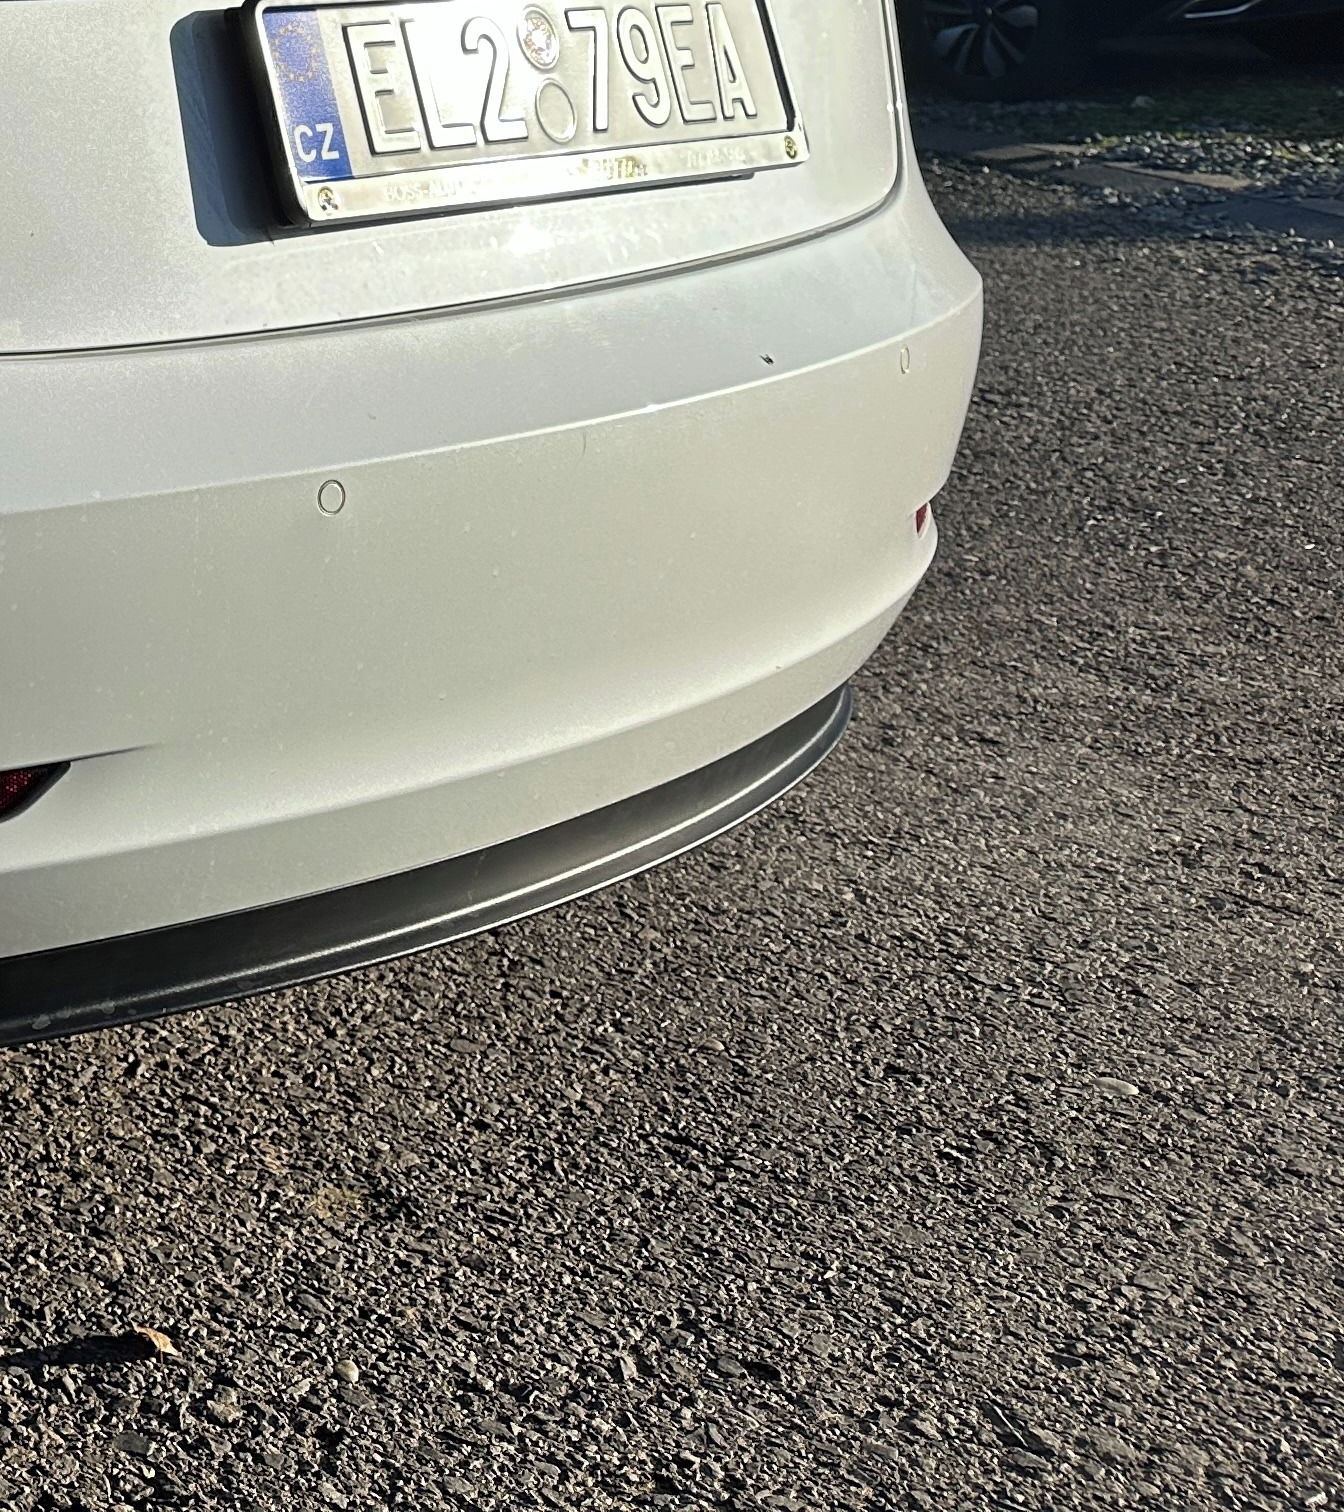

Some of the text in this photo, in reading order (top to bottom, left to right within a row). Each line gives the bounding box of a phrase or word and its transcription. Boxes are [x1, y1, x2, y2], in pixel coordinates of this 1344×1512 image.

[341, 2, 758, 156] EL2 79EA
[292, 122, 341, 164] CZ
